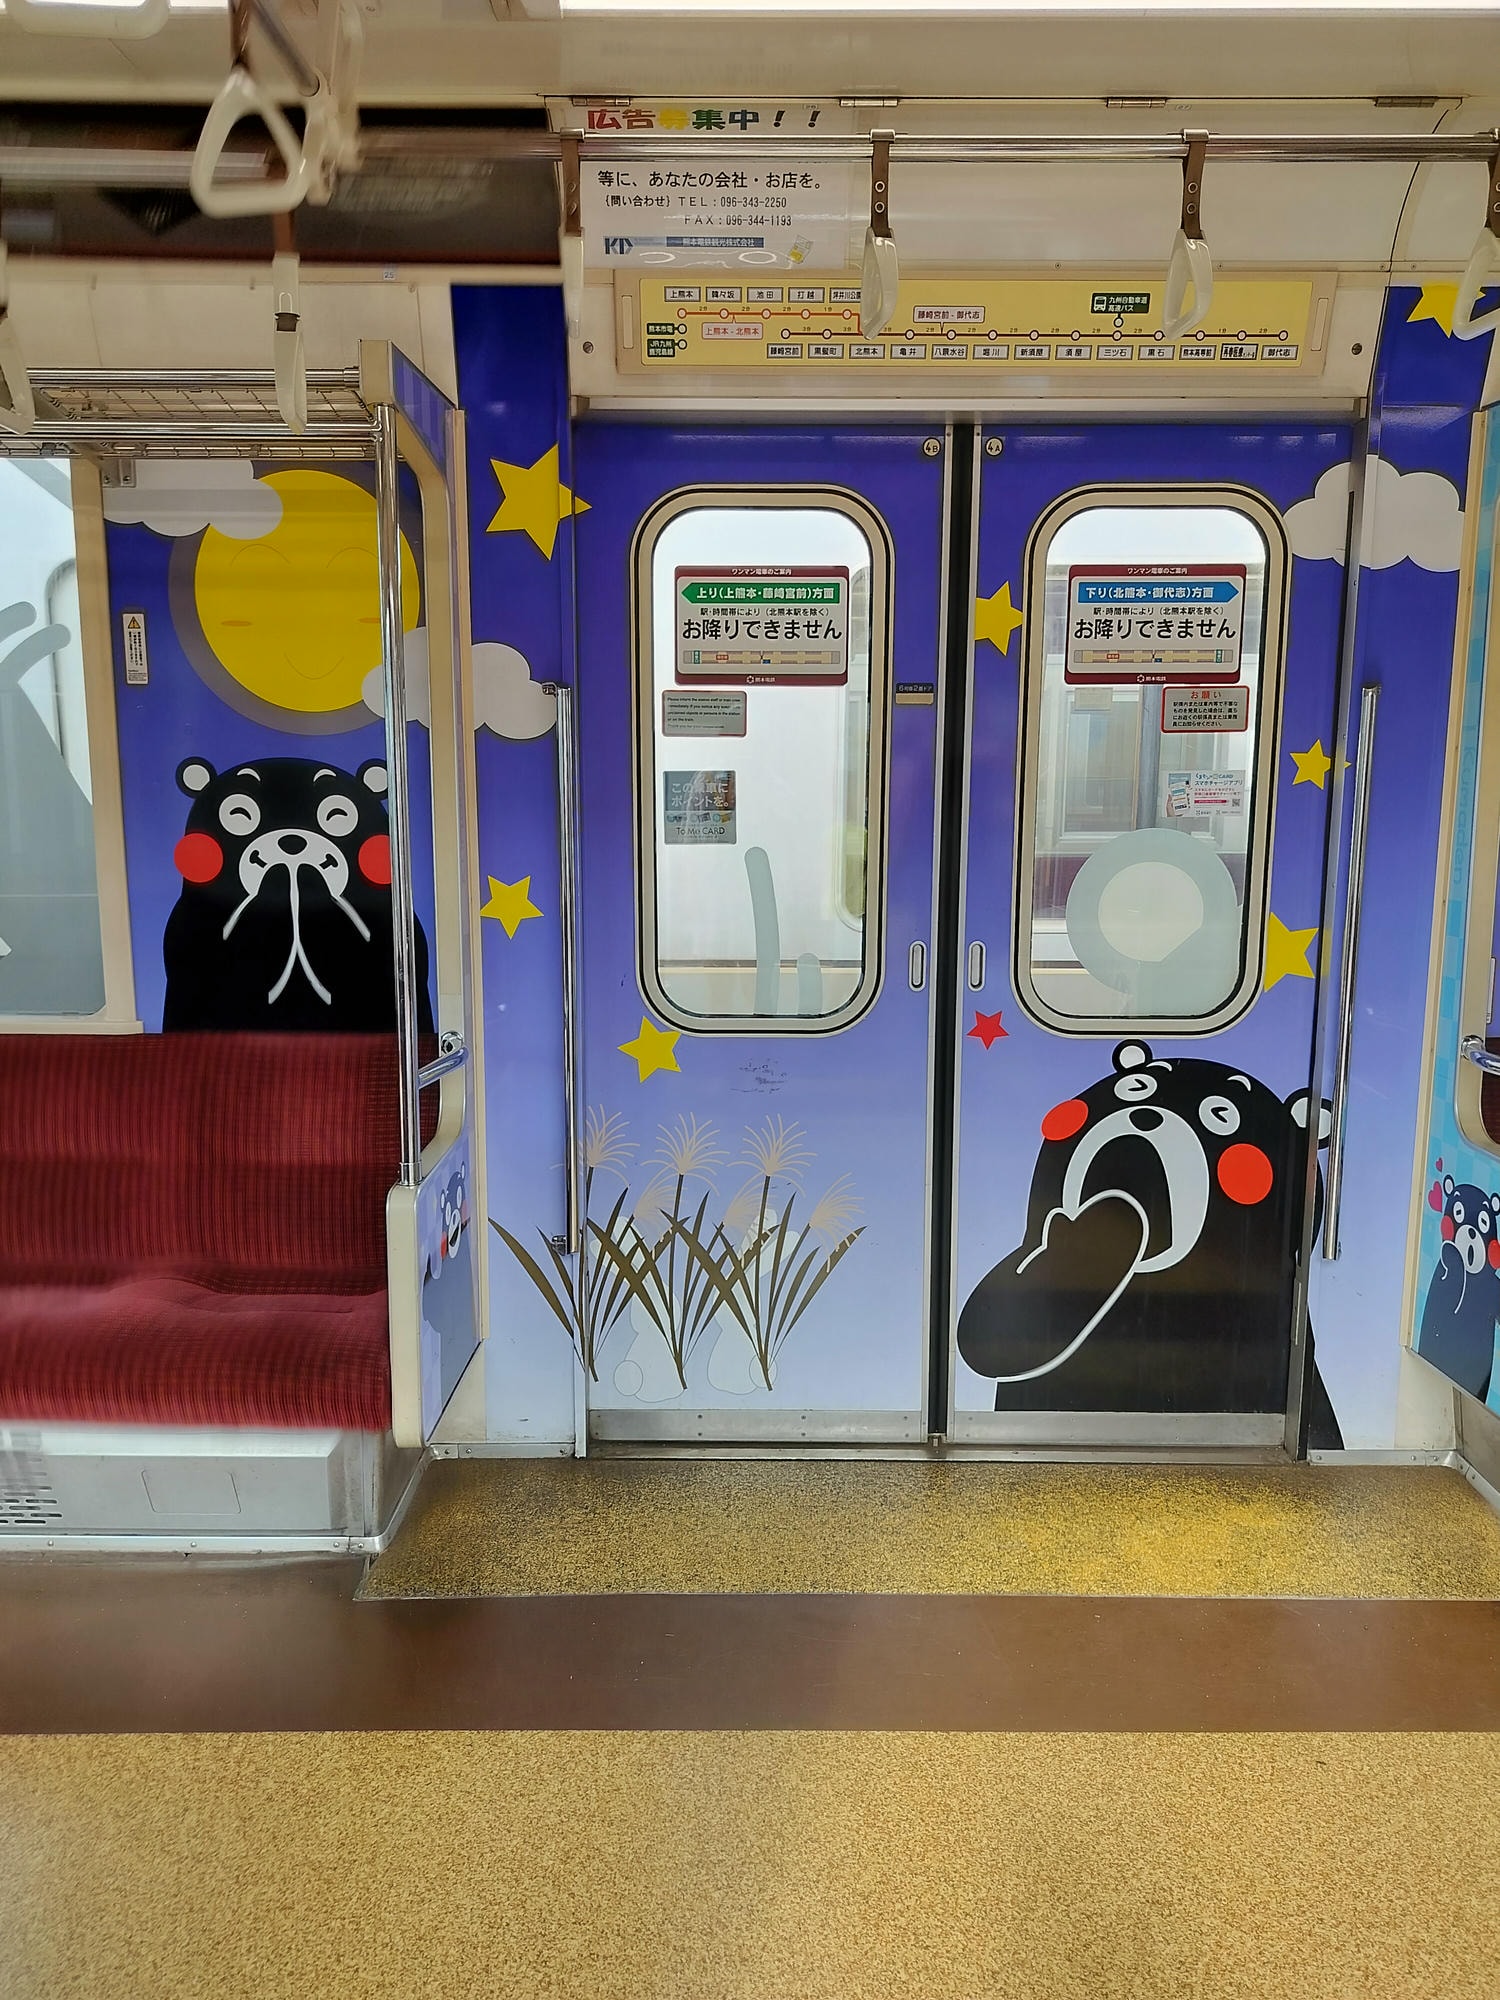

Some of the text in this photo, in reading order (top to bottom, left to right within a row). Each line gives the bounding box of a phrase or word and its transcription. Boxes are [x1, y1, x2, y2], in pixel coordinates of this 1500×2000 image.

[598, 171, 822, 189] 等に、あなたの会社・お店を。
[670, 290, 693, 299] 上熊本
[756, 291, 774, 300] 池田
[797, 291, 815, 300] 打越
[814, 347, 837, 356] 黒髪町
[856, 347, 878, 355] 北熊本
[934, 349, 964, 357] 八景水谷
[982, 349, 1000, 357] 堀川
[1020, 349, 1044, 357] 新須屋
[1065, 349, 1082, 357] 須屋
[1104, 349, 1127, 357] 三ツ石
[1147, 349, 1165, 357] 黒石
[1268, 348, 1291, 357] 御代志
[682, 619, 842, 640] お降りできません
[1074, 618, 1236, 640] お降りできません
[1191, 690, 1222, 700] お願い
